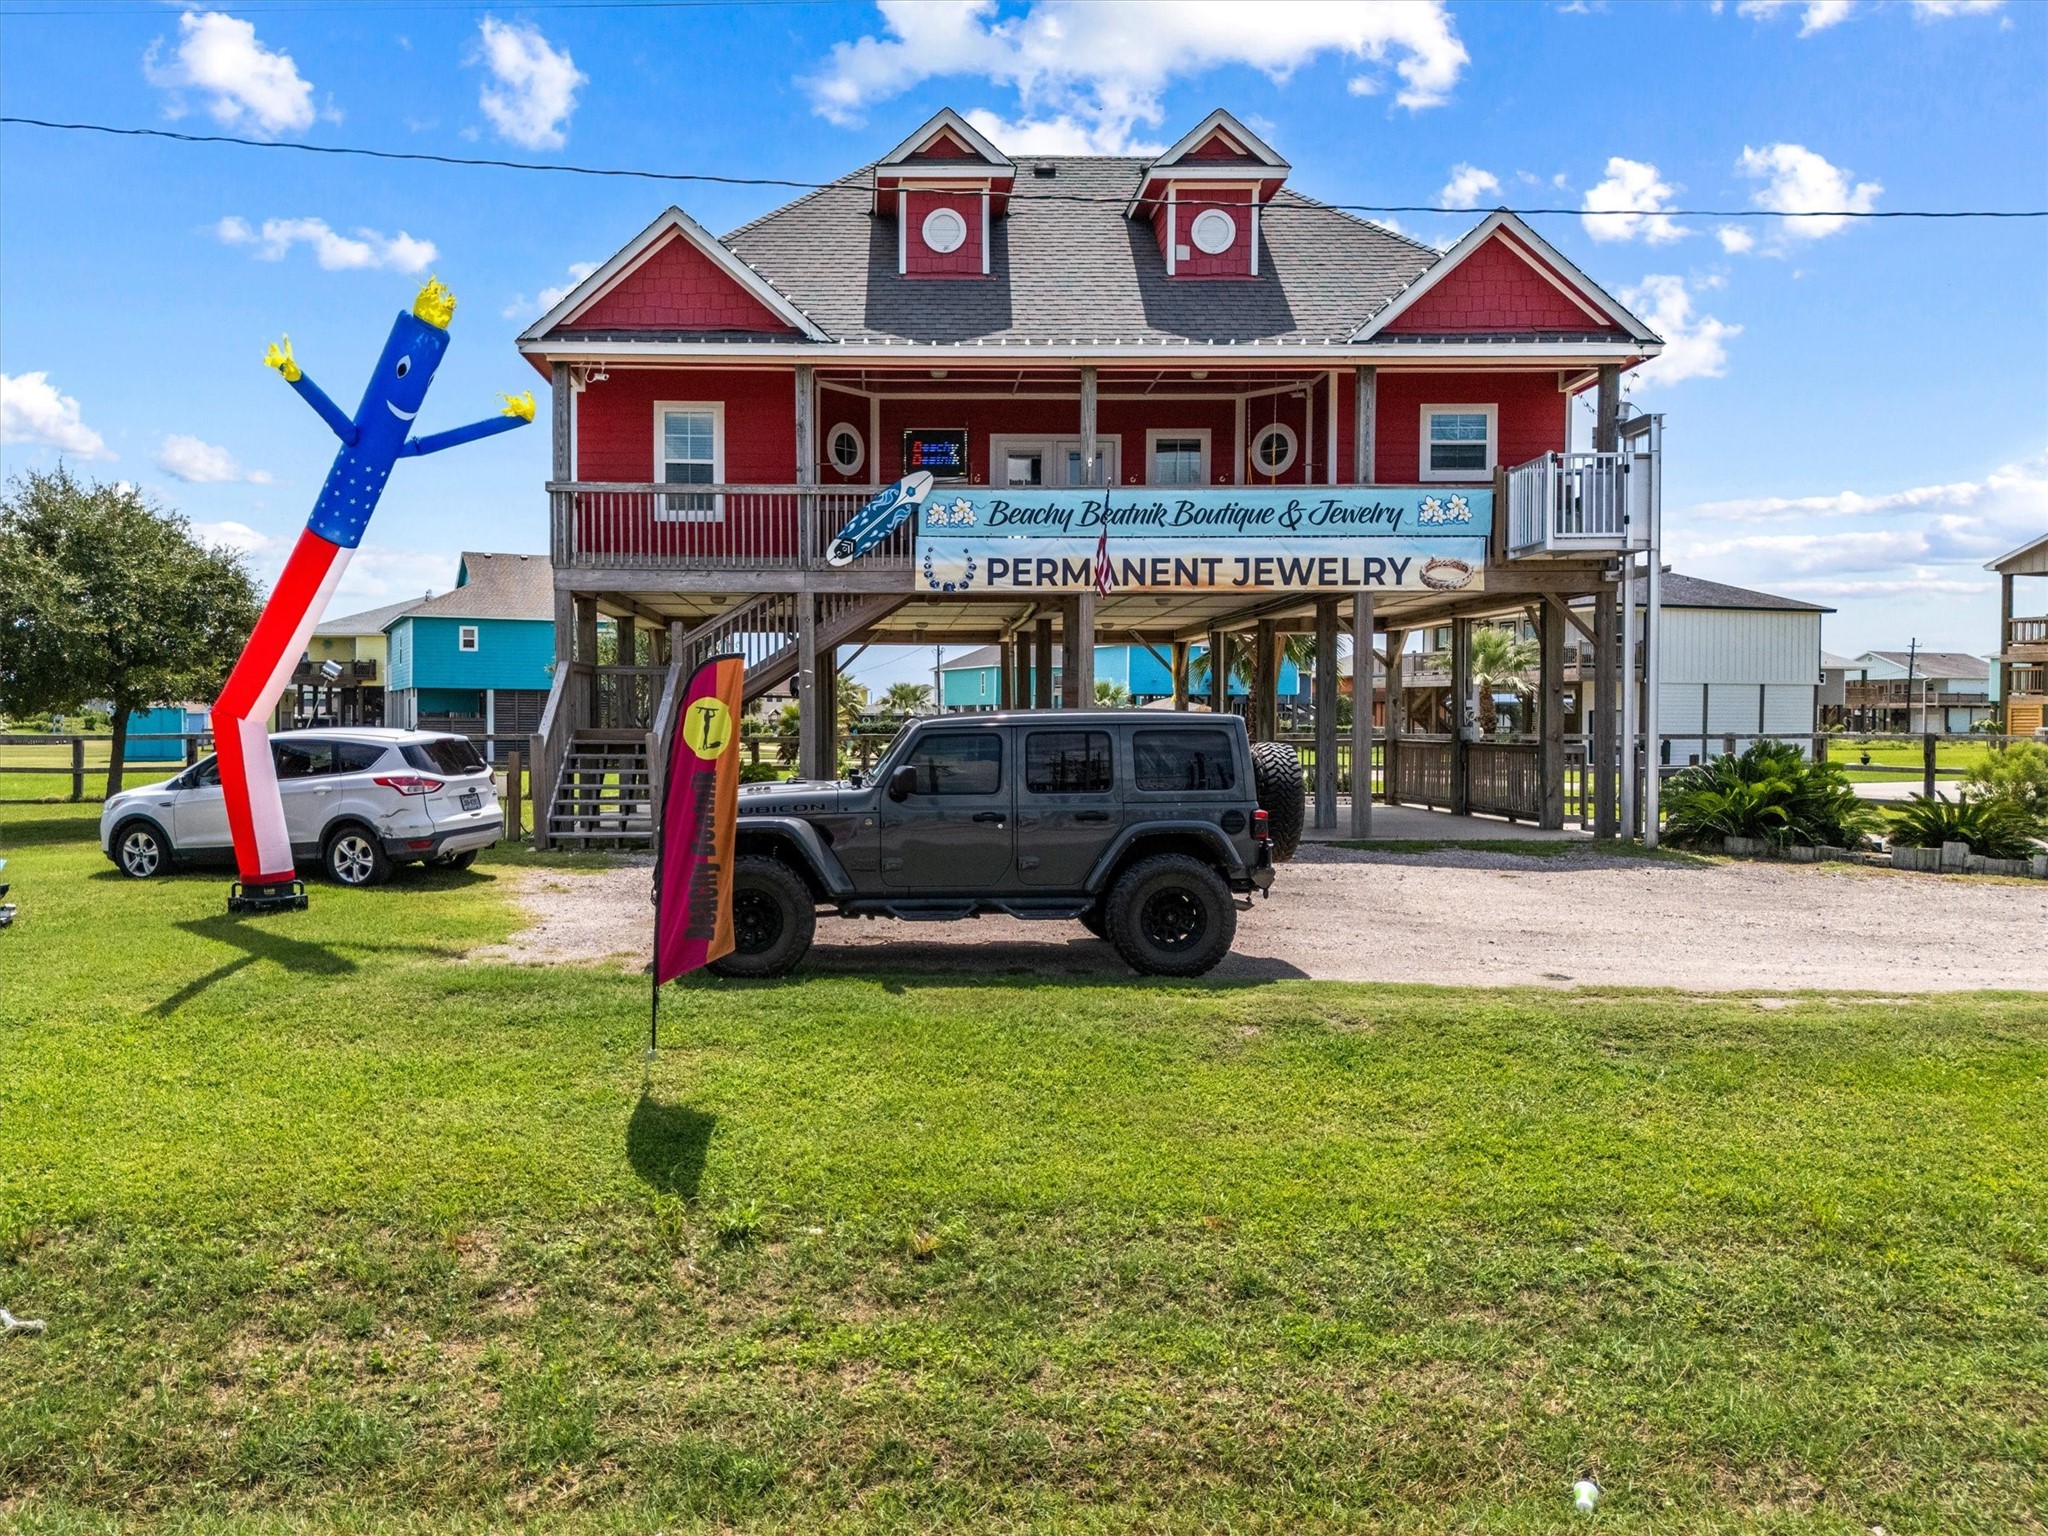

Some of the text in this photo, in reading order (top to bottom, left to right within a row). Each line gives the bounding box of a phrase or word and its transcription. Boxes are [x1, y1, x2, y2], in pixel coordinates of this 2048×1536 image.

[983, 500, 1404, 532] Beachy Beatnik Boutique & Jewelry
[1232, 557, 1412, 586] JEWELRY
[739, 803, 826, 815] UBICON
